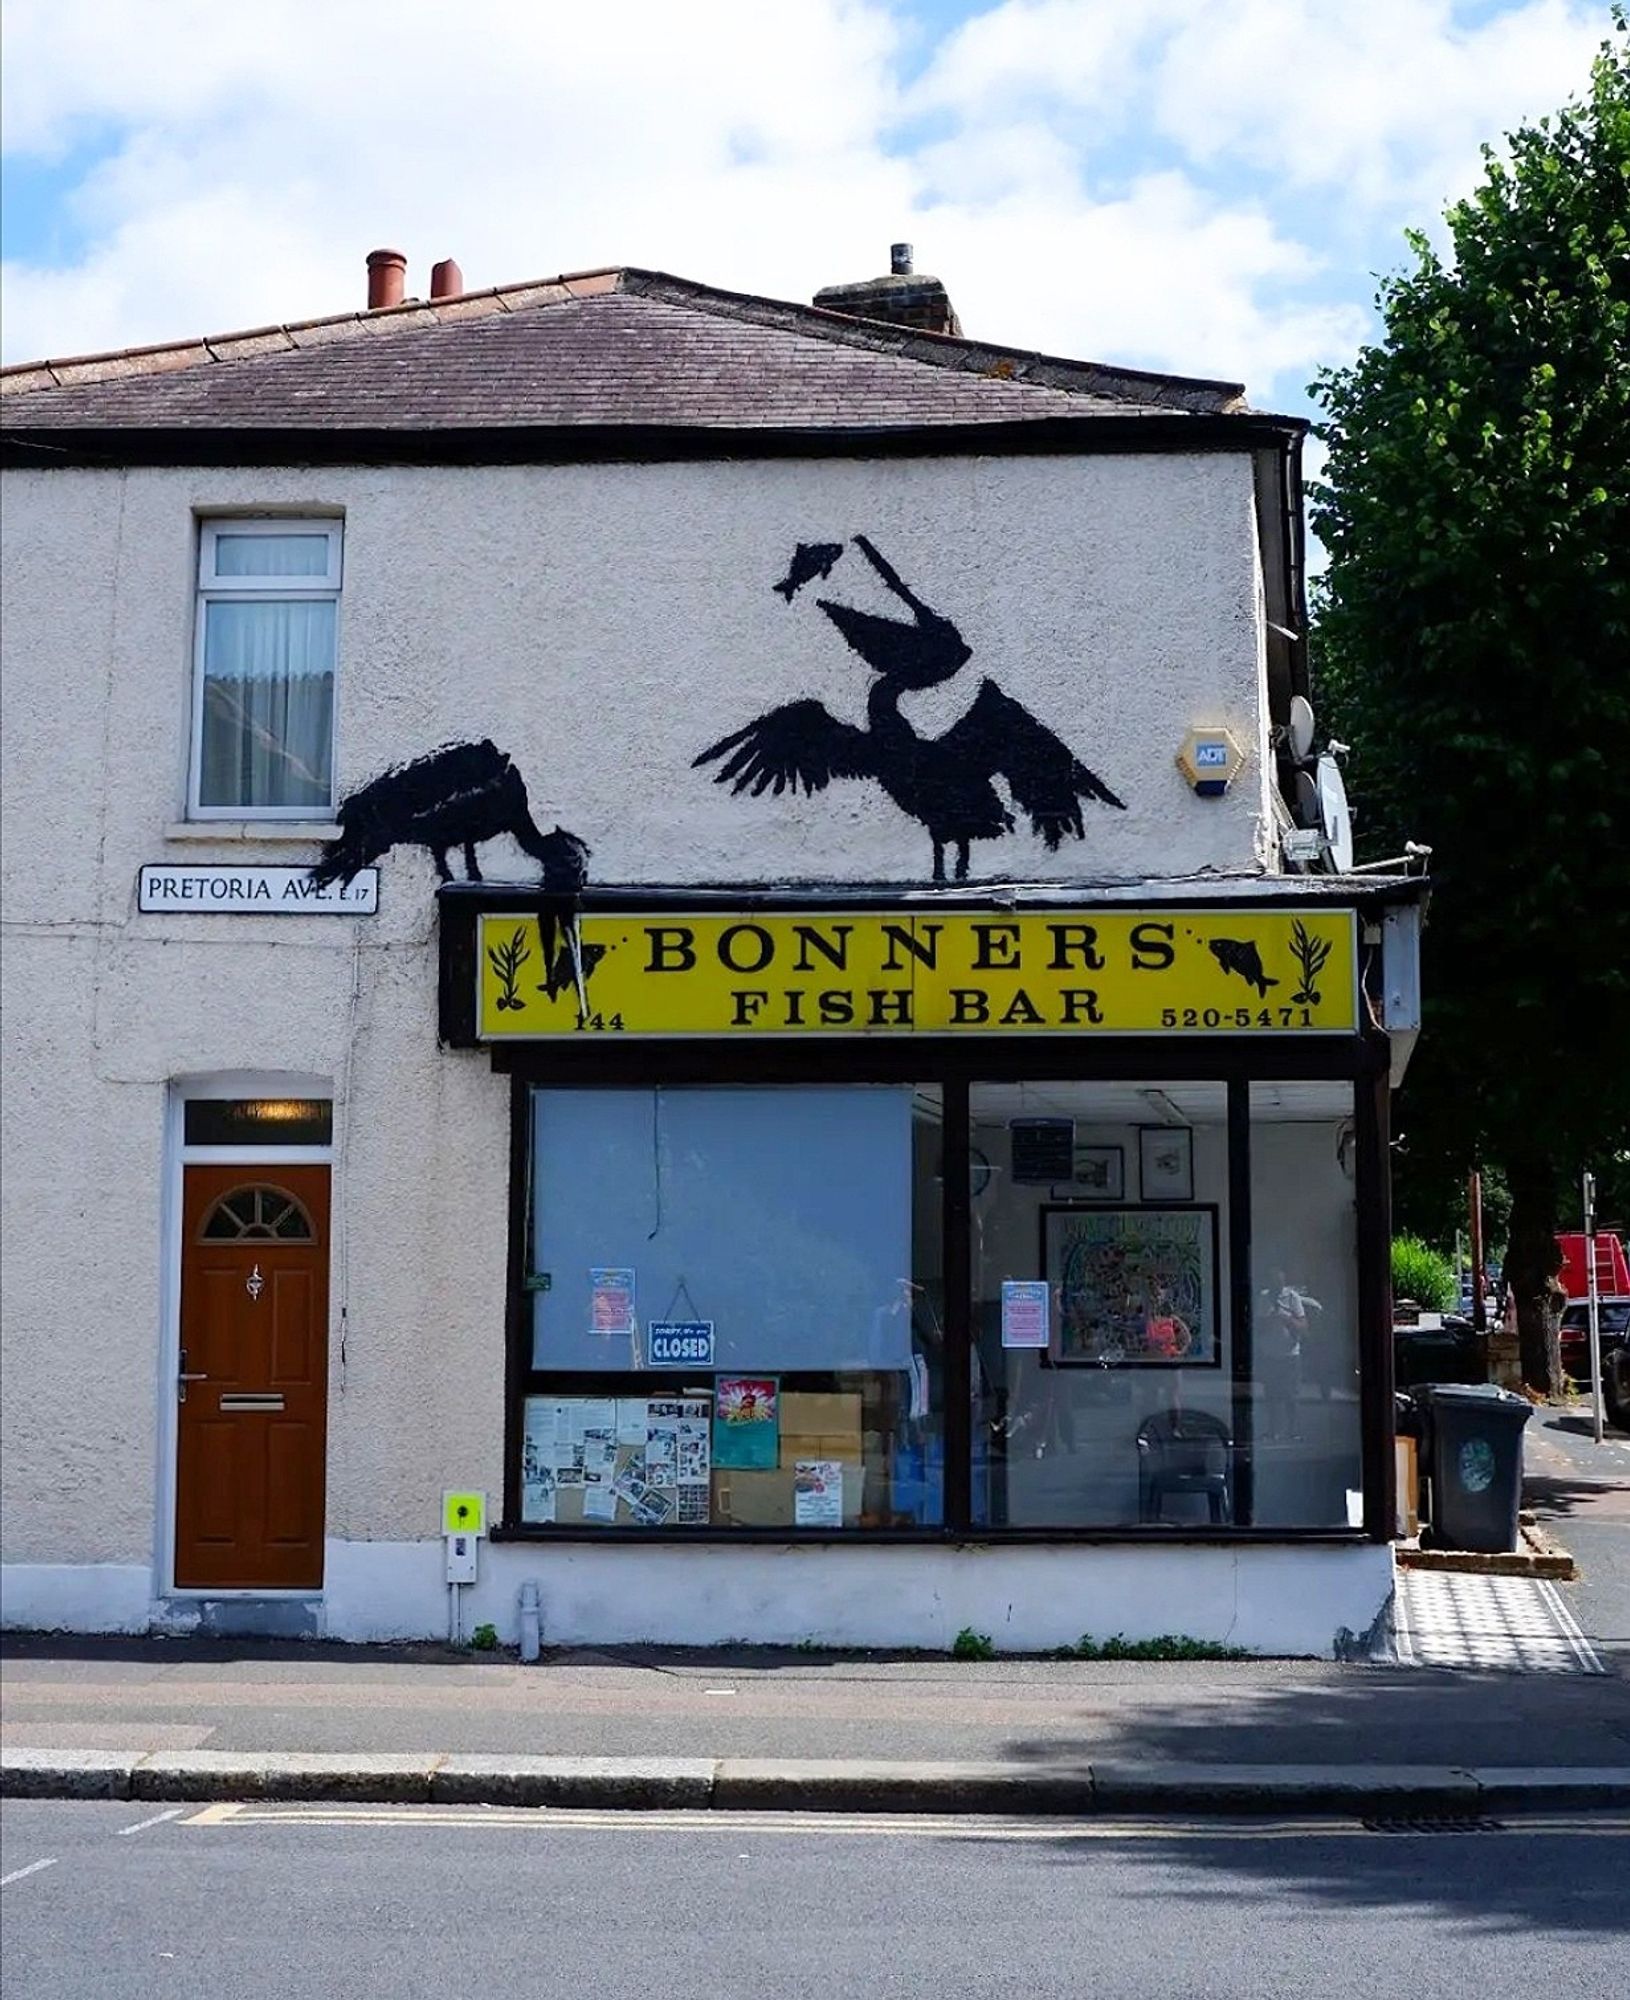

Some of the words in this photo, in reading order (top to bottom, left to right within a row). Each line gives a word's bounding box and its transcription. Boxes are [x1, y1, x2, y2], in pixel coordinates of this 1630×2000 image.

[1199, 748, 1226, 763] ADT
[149, 878, 271, 899] PRETORIA
[643, 924, 1175, 973] BONNERS
[730, 989, 913, 1026] FISH
[948, 988, 1104, 1025] BAR
[575, 1010, 625, 1030] 144
[1161, 1008, 1315, 1028] 520-5471
[654, 1338, 709, 1358] CLOSED
